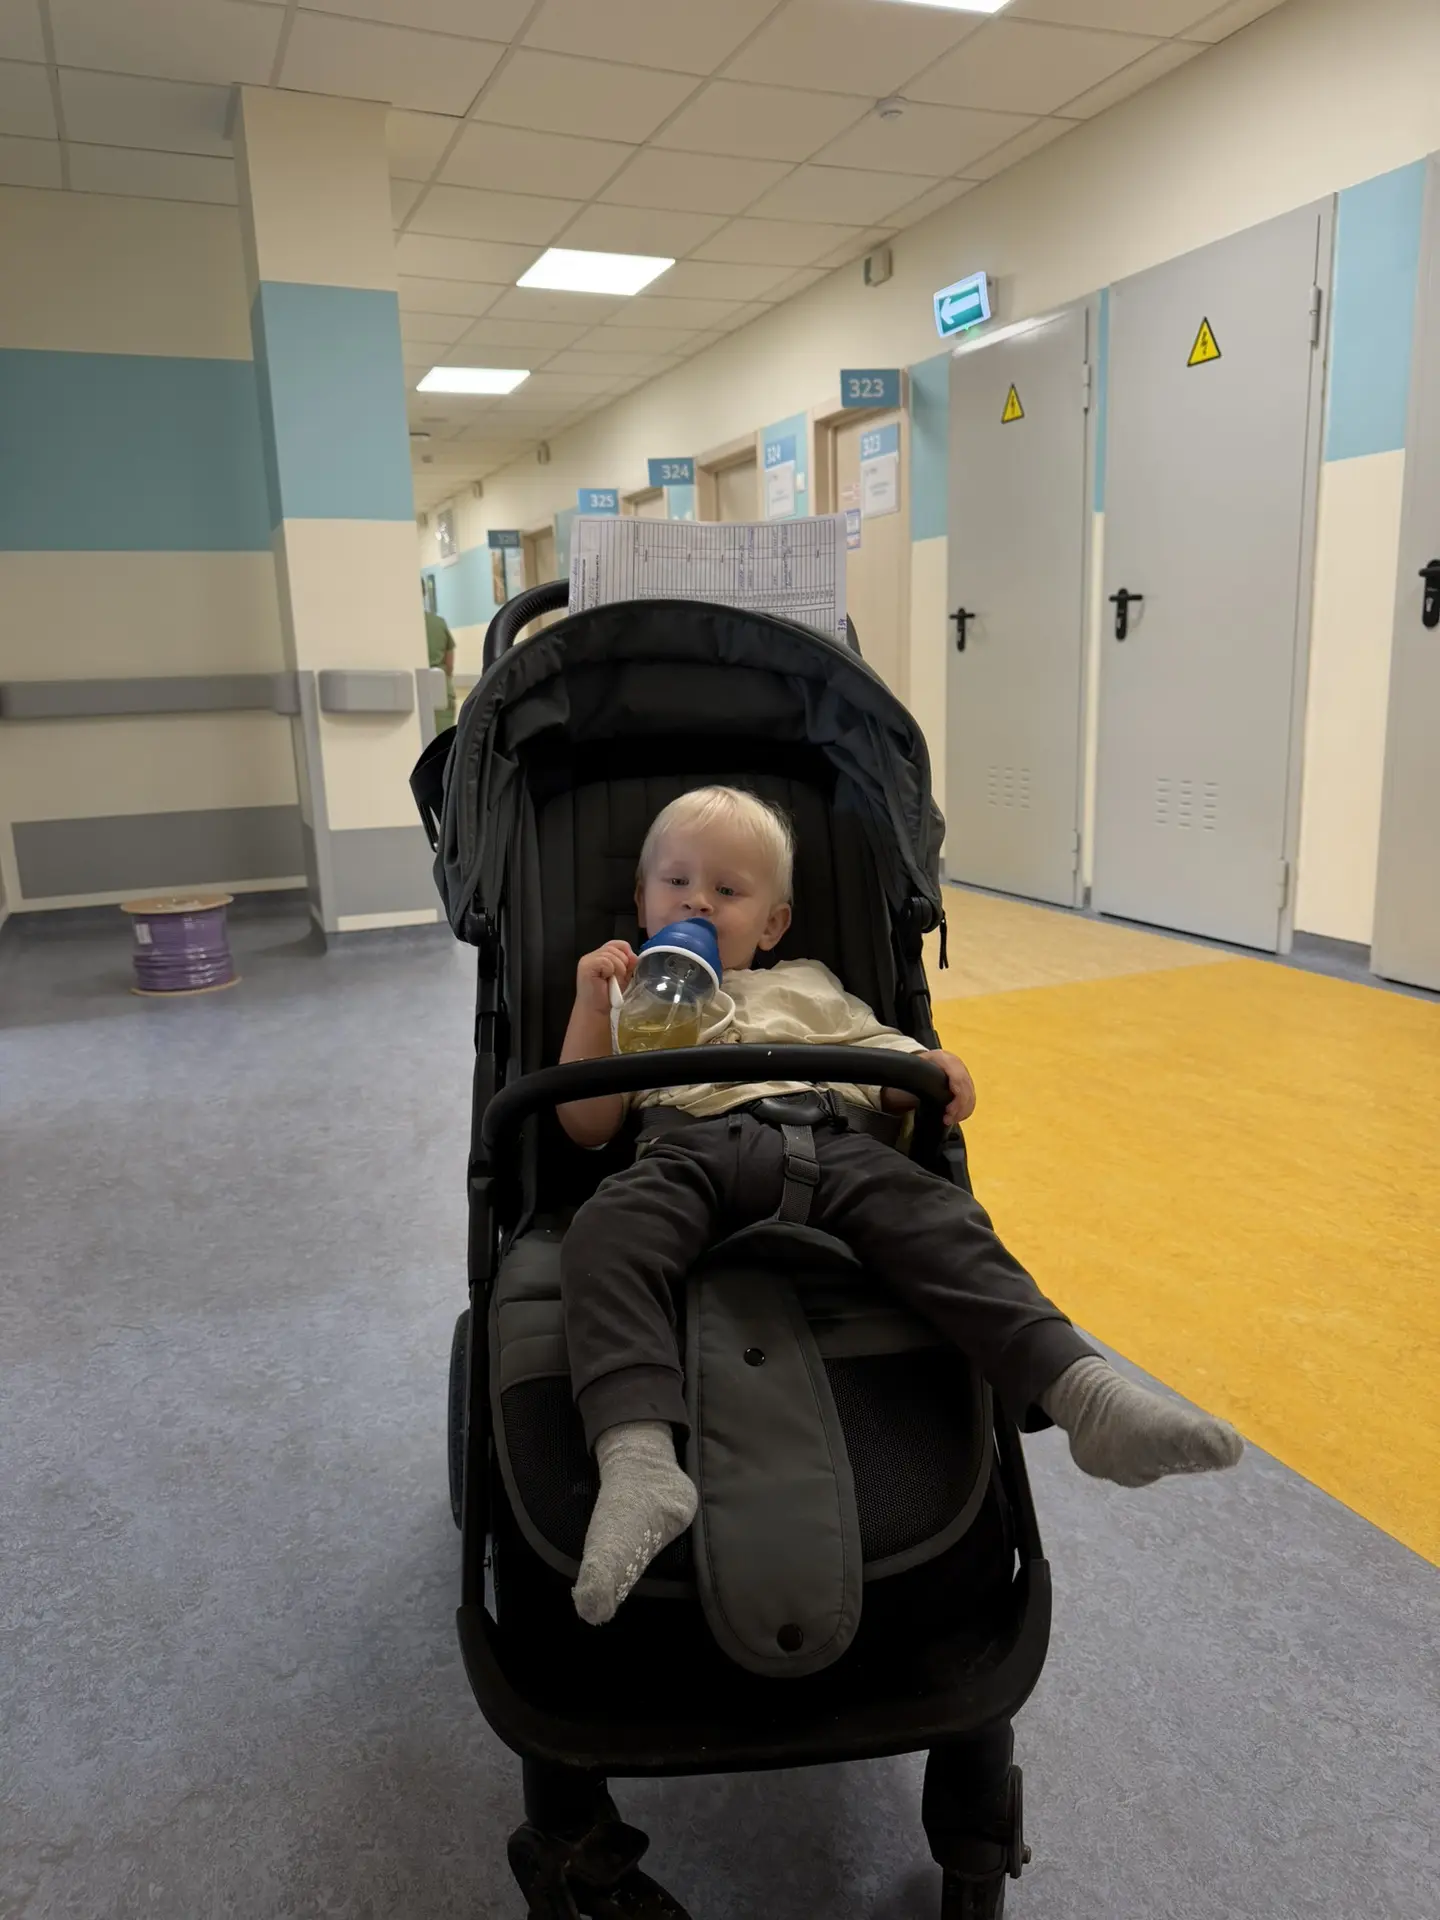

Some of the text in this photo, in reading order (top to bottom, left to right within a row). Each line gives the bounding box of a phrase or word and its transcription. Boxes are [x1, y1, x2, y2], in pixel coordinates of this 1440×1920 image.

[849, 379, 885, 397] 323
[661, 464, 688, 478] 324
[590, 494, 614, 508] 325
